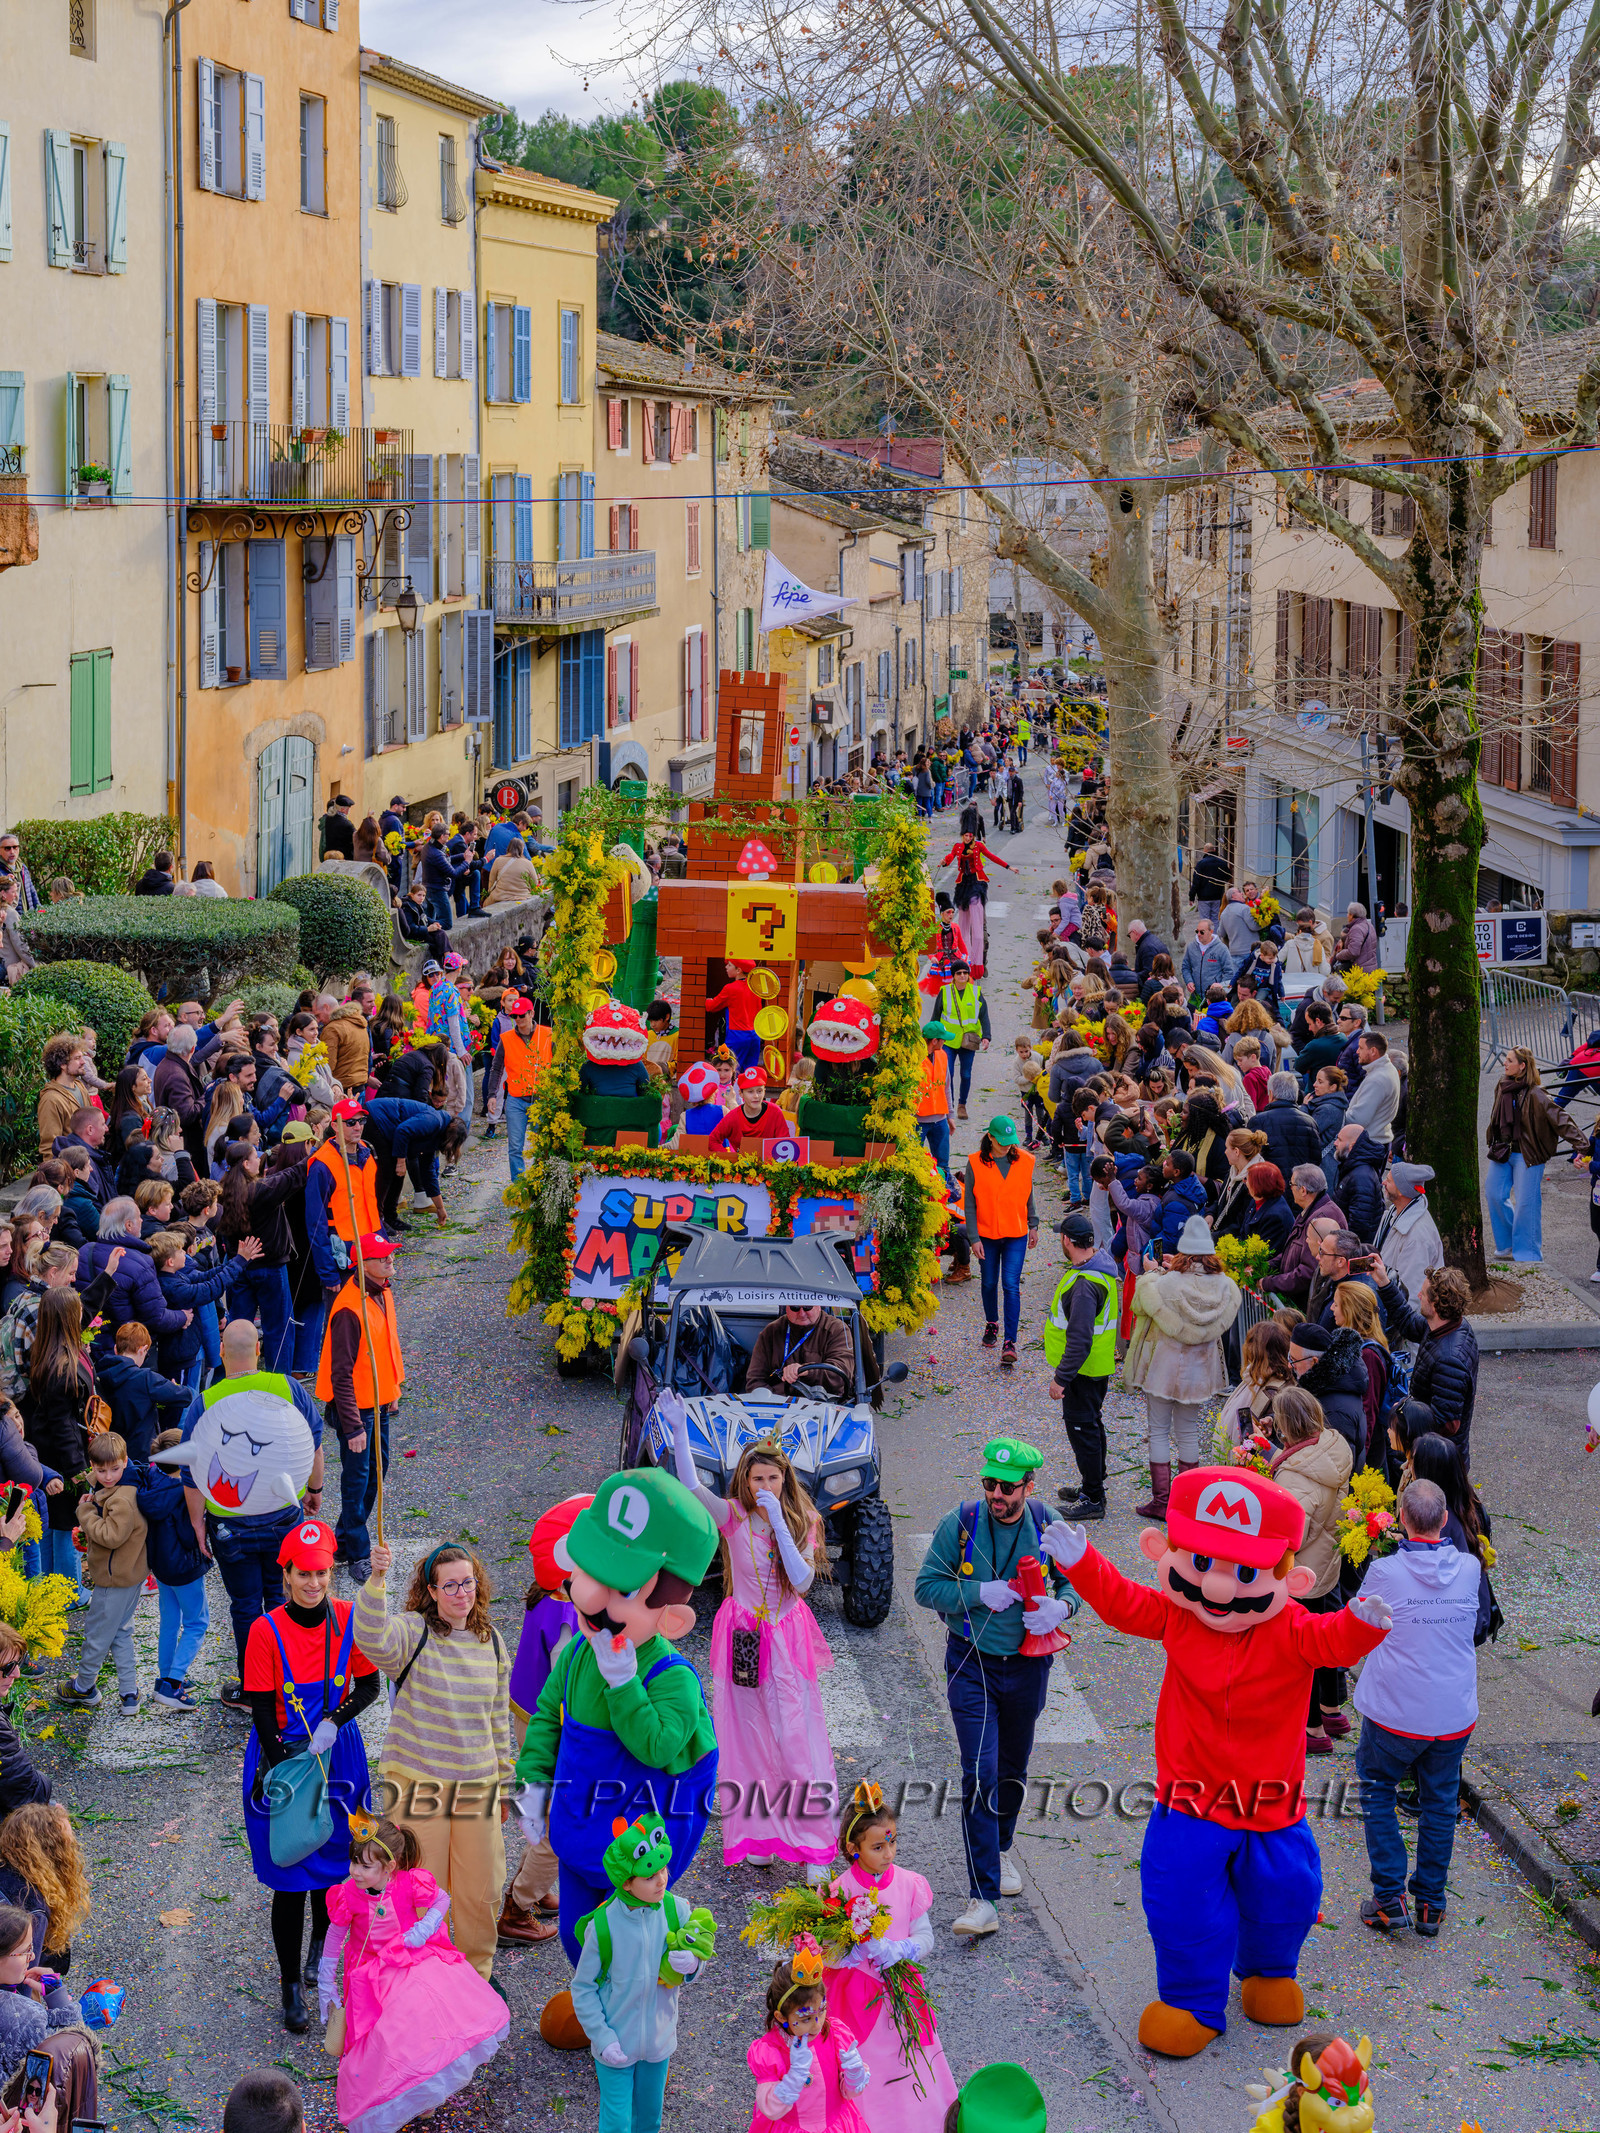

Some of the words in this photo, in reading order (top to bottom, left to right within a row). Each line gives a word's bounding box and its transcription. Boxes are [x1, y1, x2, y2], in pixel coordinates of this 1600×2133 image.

[771, 581, 813, 609] fcpe
[502, 789, 516, 807] B
[1474, 924, 1490, 932] TO
[1475, 933, 1491, 941] TO
[1476, 942, 1493, 950] OLE
[775, 1141, 795, 1164] 9
[600, 1190, 748, 1235] SUPER
[738, 1291, 775, 1300] Loisirs
[778, 1291, 824, 1301] Attitude
[999, 1450, 1006, 1461] L
[617, 1494, 634, 1531] L
[1205, 1490, 1252, 1526] M
[302, 1528, 319, 1540] M
[1407, 1598, 1434, 1606] Réserve
[1435, 1597, 1470, 1605] Communale
[1422, 1617, 1448, 1625] Sécurité
[1449, 1616, 1467, 1624] Civile
